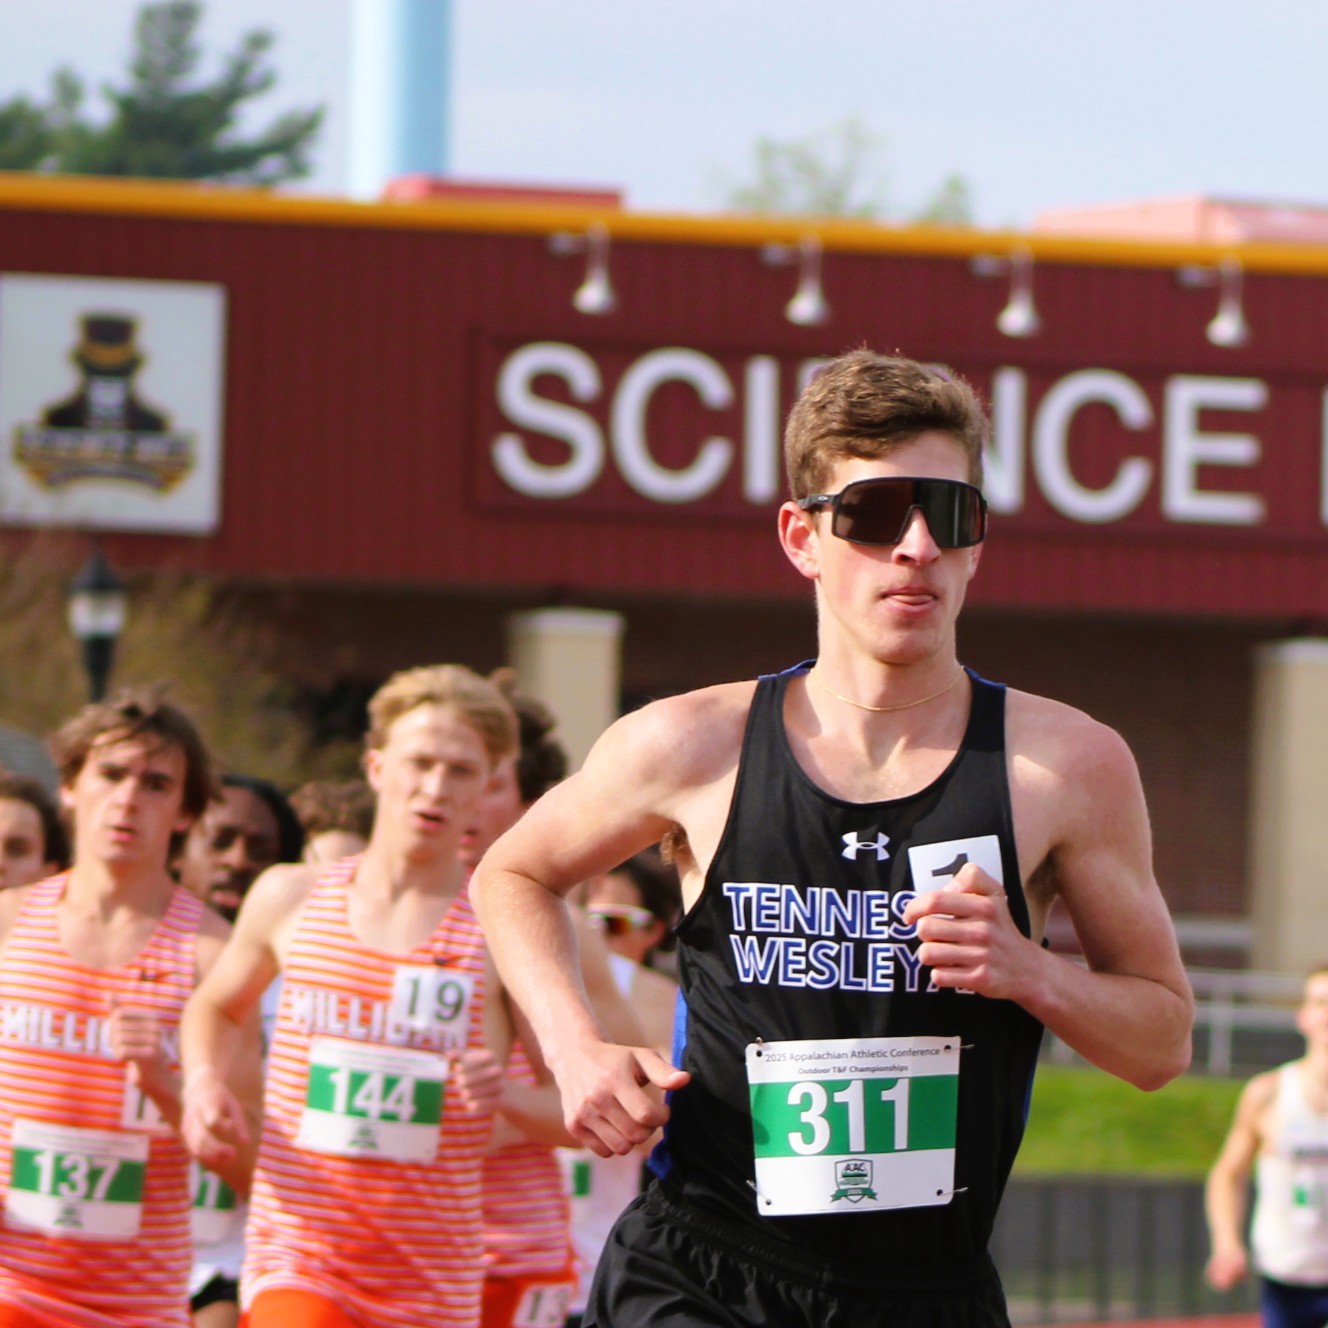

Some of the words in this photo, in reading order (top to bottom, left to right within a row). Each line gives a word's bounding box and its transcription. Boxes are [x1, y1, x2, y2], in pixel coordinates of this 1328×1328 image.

[491, 341, 1268, 526] SCINCE
[722, 882, 919, 940] TENNES
[729, 934, 972, 994] WESLEY
[405, 975, 465, 1023] 19
[765, 1053, 787, 1062] 2025
[789, 1050, 848, 1063] Appalachian
[850, 1049, 888, 1059] Athletic
[890, 1047, 940, 1057] Conference
[849, 1064, 908, 1075] Championships
[329, 1066, 418, 1122] 144
[787, 1077, 910, 1156] 311
[33, 1149, 121, 1201] 137
